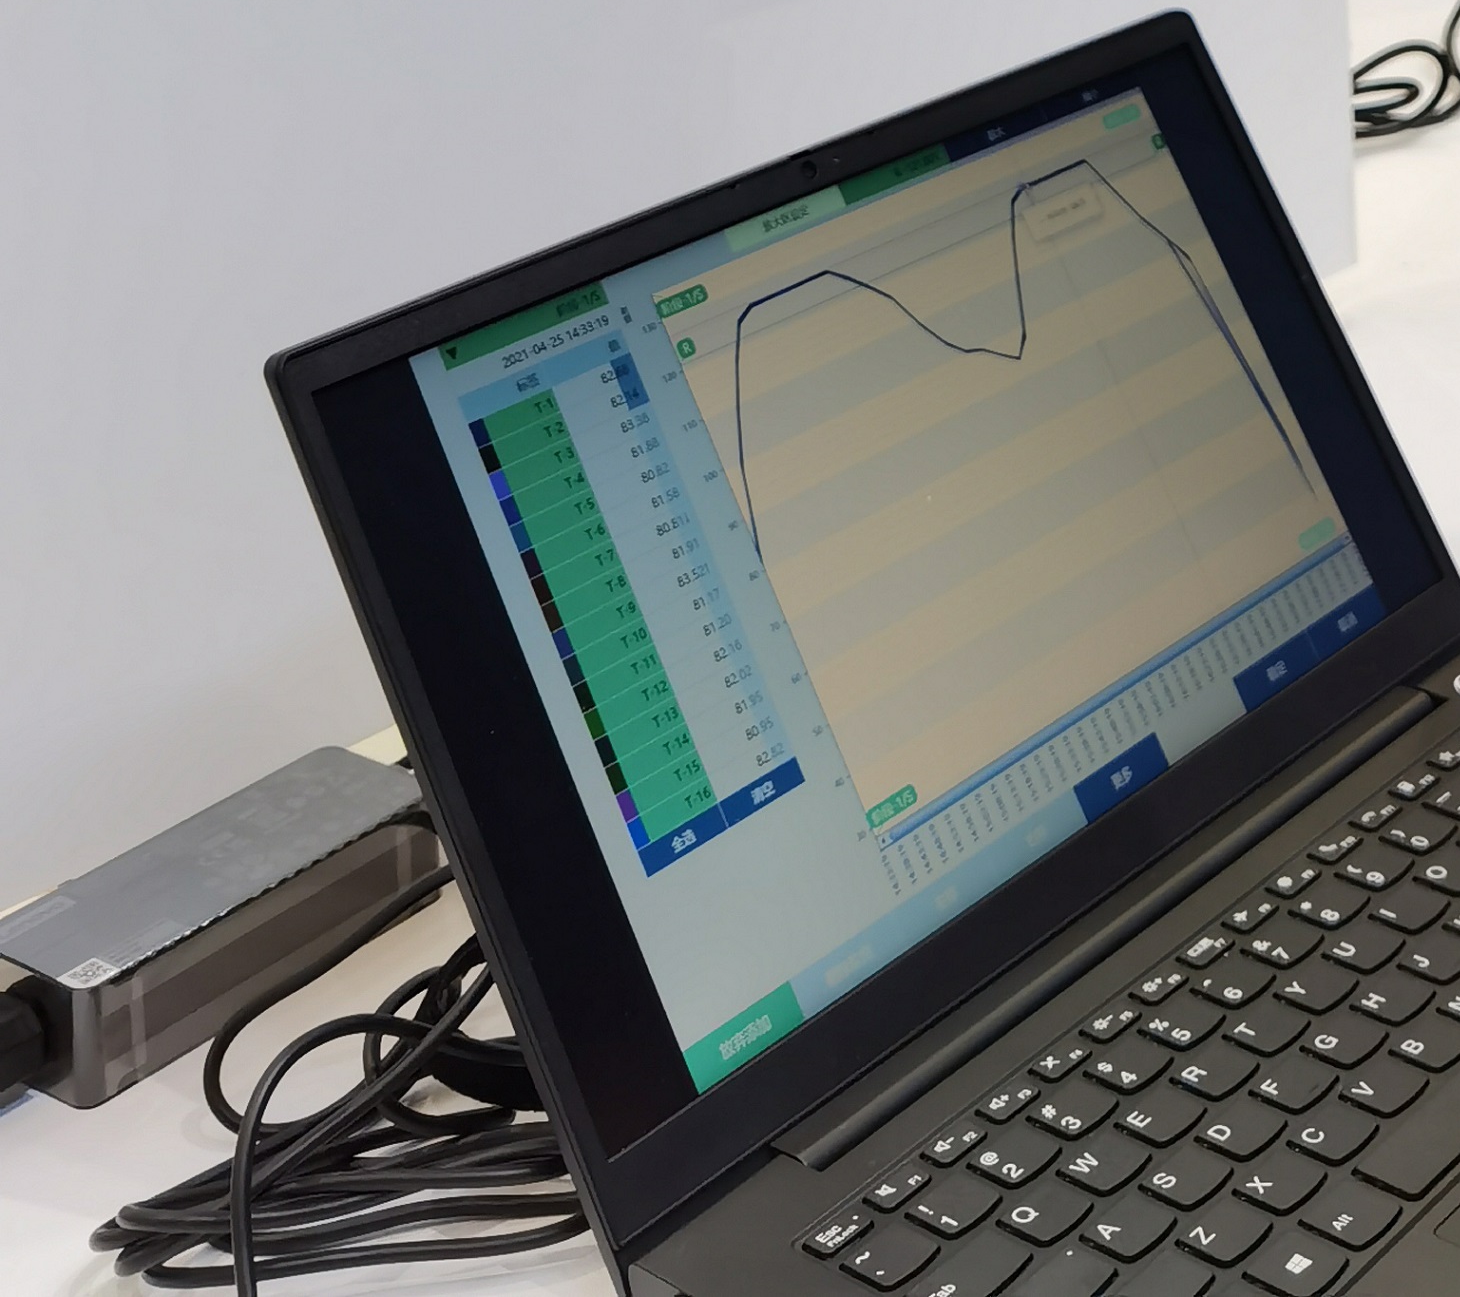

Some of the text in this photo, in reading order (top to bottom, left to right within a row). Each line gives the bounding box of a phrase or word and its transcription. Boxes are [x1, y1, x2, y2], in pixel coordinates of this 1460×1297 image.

[1366, 871, 1385, 885] 9
[1426, 866, 1448, 879] O
[1320, 909, 1340, 922] 8
[1379, 908, 1397, 919] I
[1272, 947, 1290, 960] 7
[1333, 942, 1356, 957] U
[1413, 955, 1430, 968] J
[1223, 987, 1243, 1001] 6
[1284, 981, 1306, 995] Y
[1361, 992, 1386, 1009] H
[1149, 1019, 1169, 1031] %
[1234, 1022, 1256, 1036] T
[1171, 1028, 1192, 1041] 5
[1314, 1035, 1339, 1050] G
[1400, 1039, 1424, 1055] B
[1120, 1071, 1137, 1084] 4
[1181, 1065, 1208, 1083] R
[1260, 1078, 1278, 1095] F
[1351, 1081, 1374, 1096] V
[1061, 1116, 1081, 1130] 3
[1126, 1110, 1152, 1128] E
[962, 1131, 978, 1142] F2
[1207, 1125, 1231, 1141] D
[1302, 1128, 1325, 1143] C
[980, 1151, 999, 1165] @
[1068, 1152, 1099, 1174] W
[1002, 1163, 1024, 1178] 2
[908, 1175, 922, 1187] F1
[1152, 1173, 1177, 1189] S
[1246, 1176, 1273, 1194] X
[940, 1215, 958, 1226] 1
[1011, 1206, 1040, 1223] Q
[1332, 1214, 1354, 1231] Alt
[816, 1225, 842, 1243] Esc
[1097, 1223, 1122, 1240] A
[1189, 1226, 1216, 1245] Z
